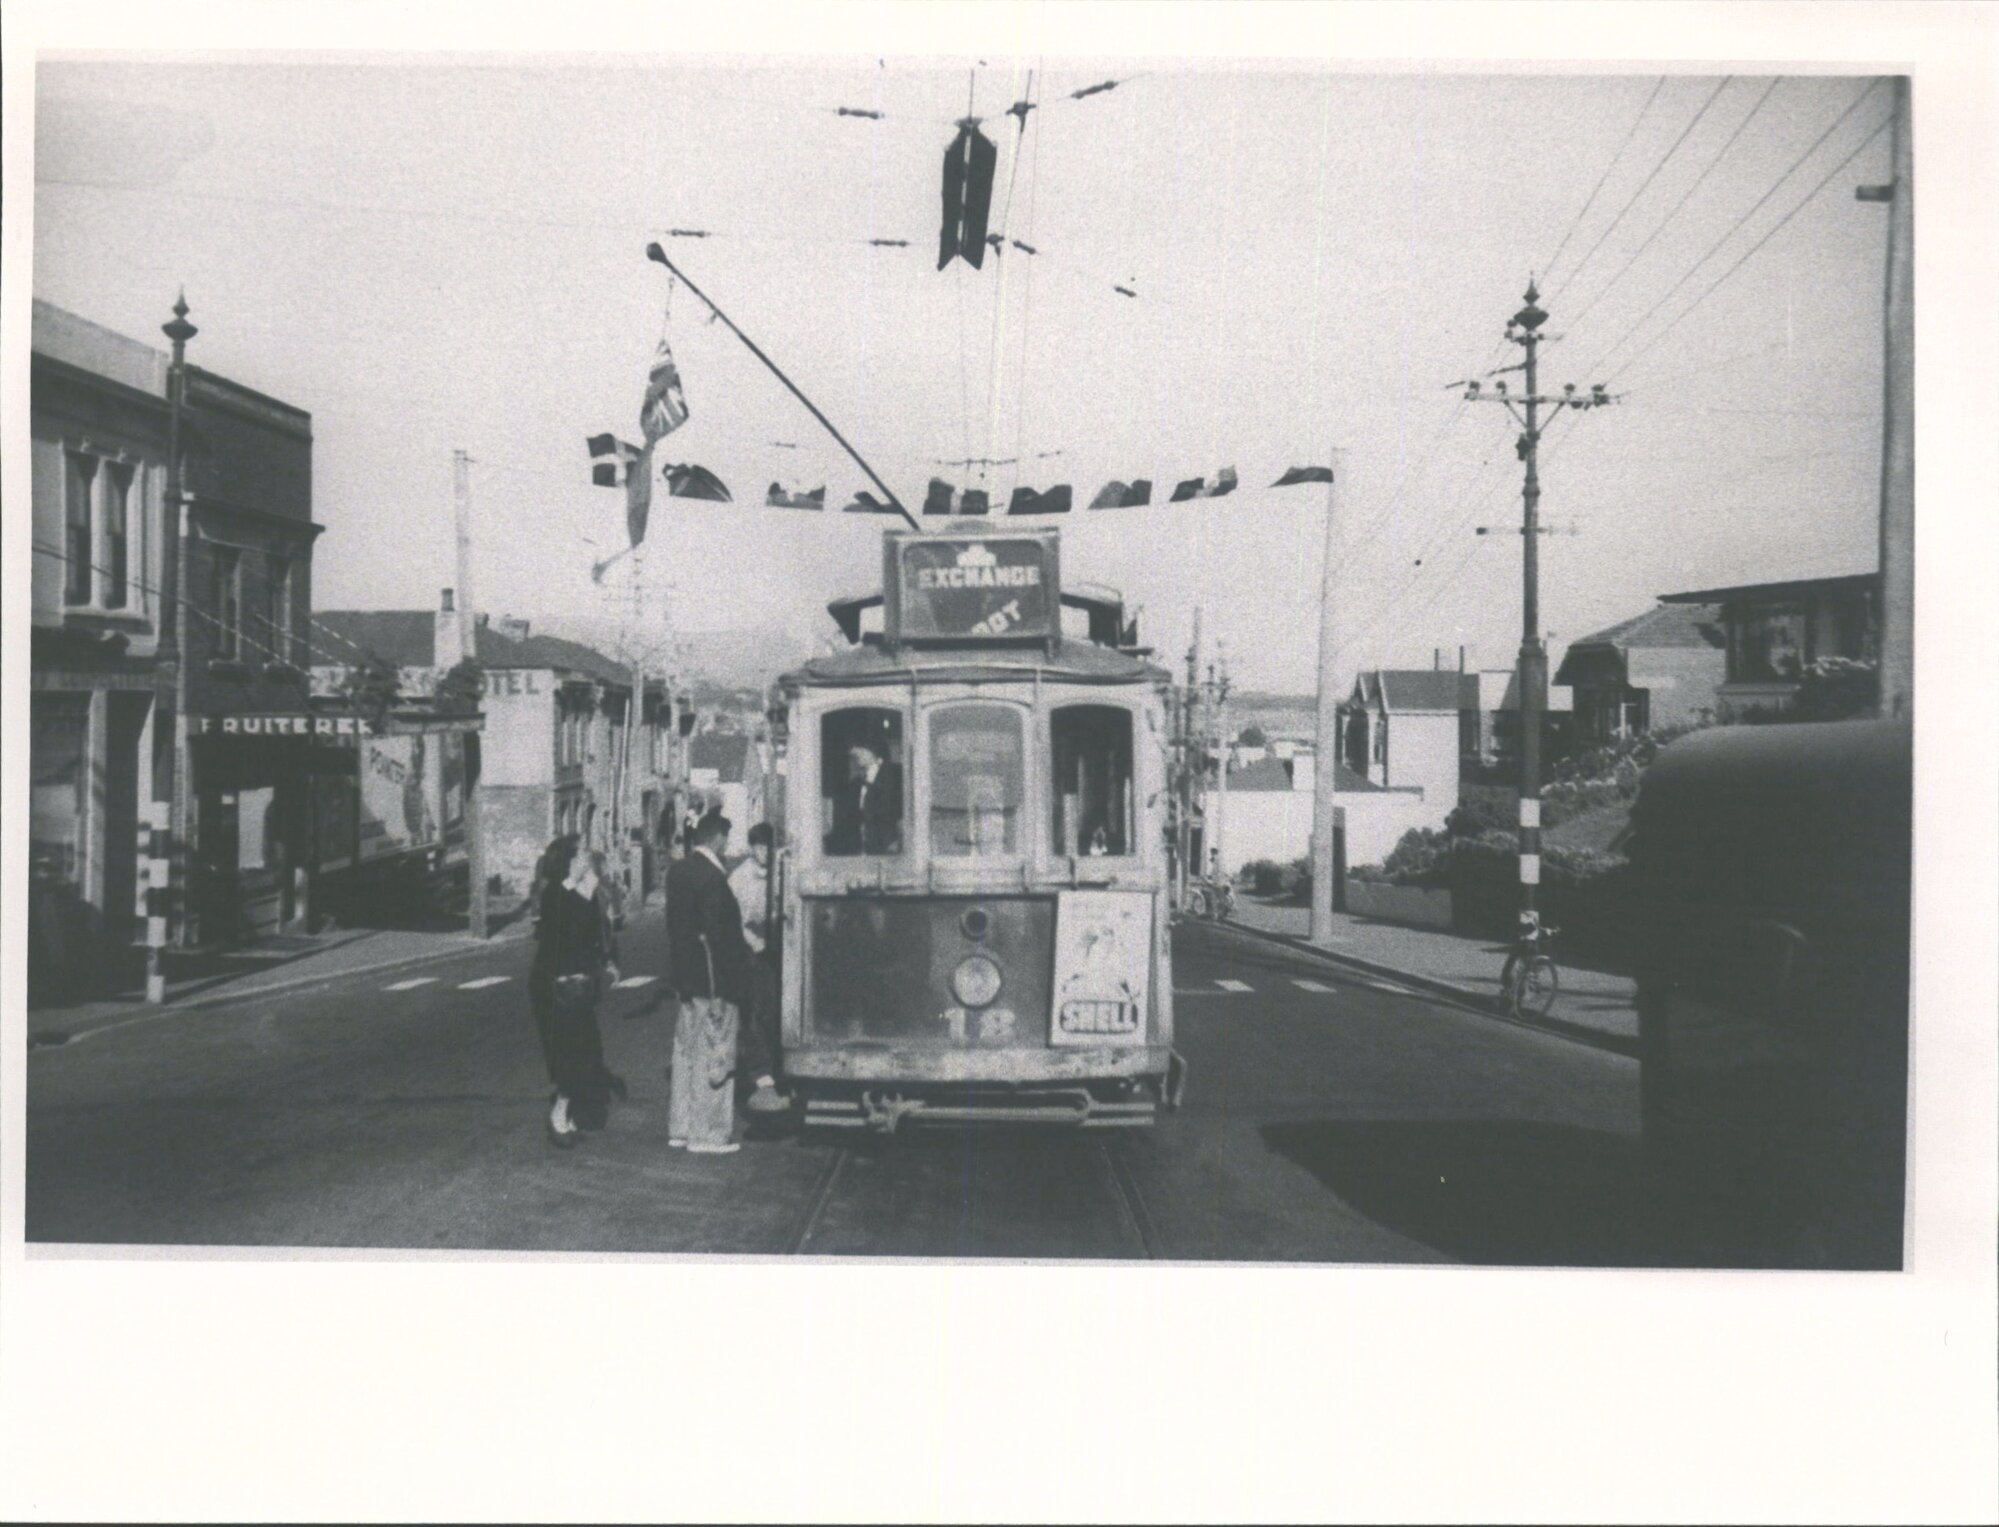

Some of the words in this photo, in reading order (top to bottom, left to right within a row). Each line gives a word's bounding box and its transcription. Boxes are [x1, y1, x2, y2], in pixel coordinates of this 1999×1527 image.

[918, 566, 1041, 589] EXCHANGE
[475, 671, 540, 696] OTEL
[1061, 1002, 1138, 1033] SHELL
